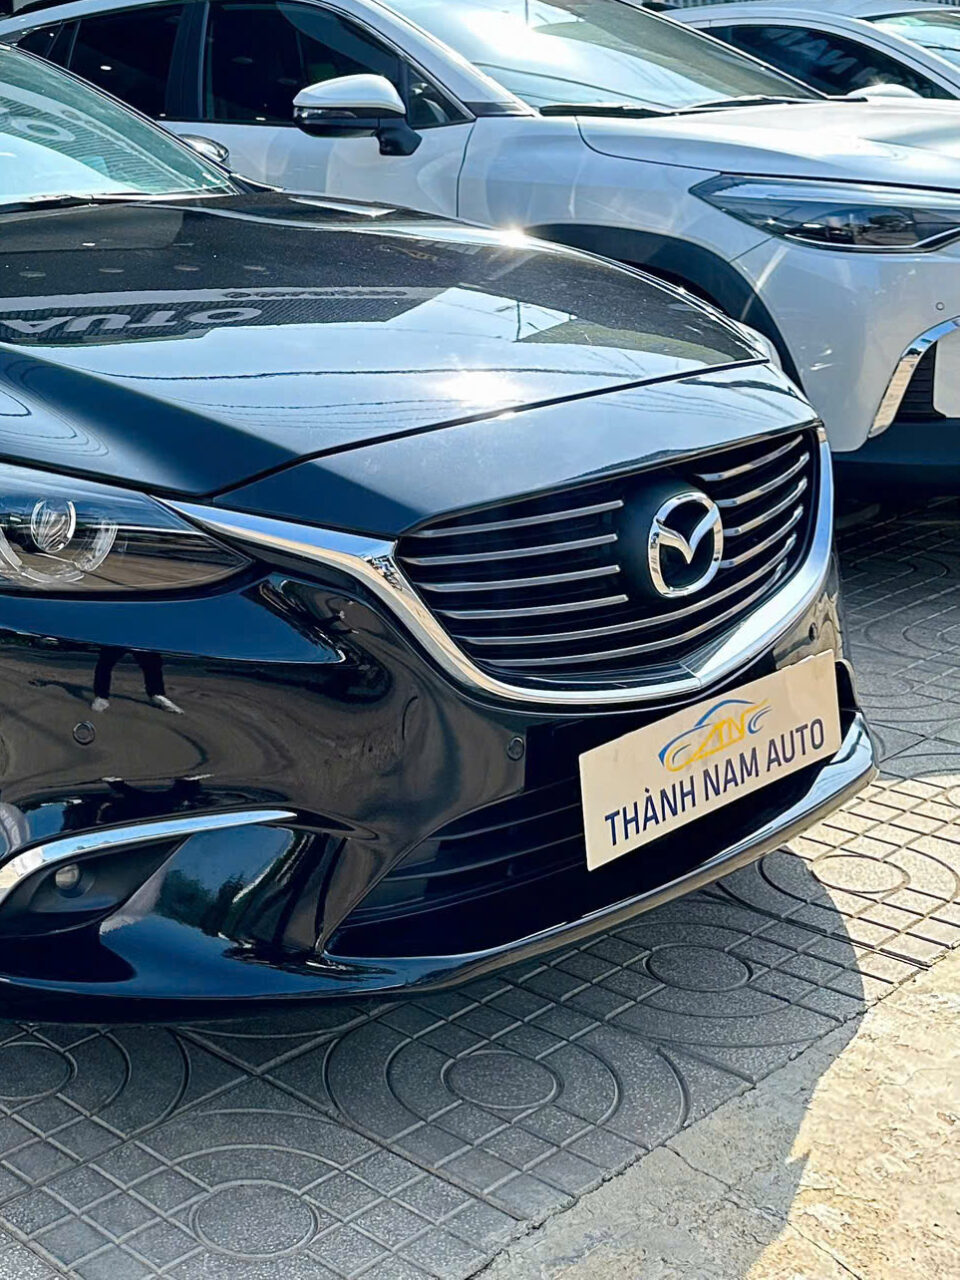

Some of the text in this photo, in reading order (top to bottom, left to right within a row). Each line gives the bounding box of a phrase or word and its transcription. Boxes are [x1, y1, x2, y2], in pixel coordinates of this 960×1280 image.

[605, 718, 825, 847] THÀNH NAM AUTO
